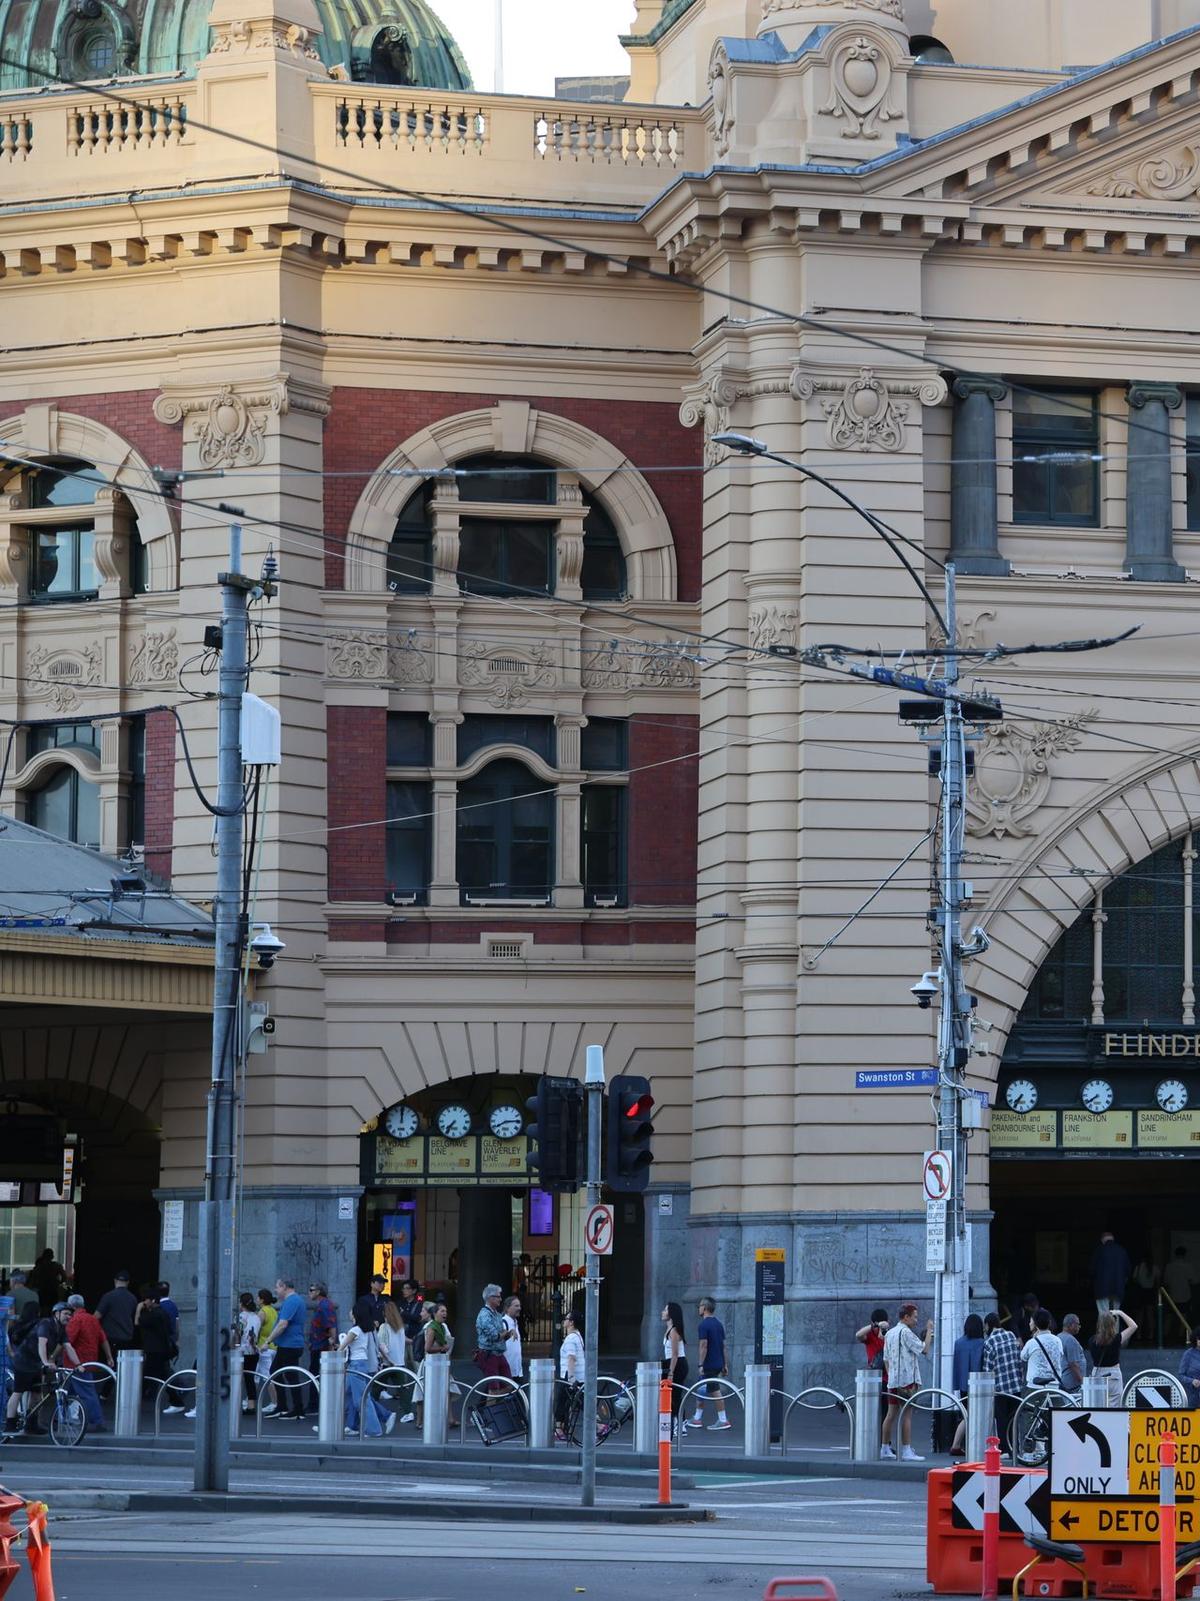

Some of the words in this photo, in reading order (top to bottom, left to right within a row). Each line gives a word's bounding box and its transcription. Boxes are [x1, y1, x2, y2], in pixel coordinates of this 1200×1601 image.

[858, 1072, 903, 1082] Swanston
[905, 1071, 915, 1080] St
[1064, 1114, 1107, 1122] FRANKSTON
[992, 1124, 1036, 1132] CRANBOURNE
[1064, 1124, 1080, 1132] LINE
[1140, 1124, 1156, 1132] LINE
[1146, 1417, 1191, 1436] ROAD
[1135, 1443, 1200, 1463] CLED
[1064, 1477, 1111, 1494] ONLY
[1139, 1471, 1195, 1490] AHAD
[1099, 1510, 1193, 1532] DETOR
